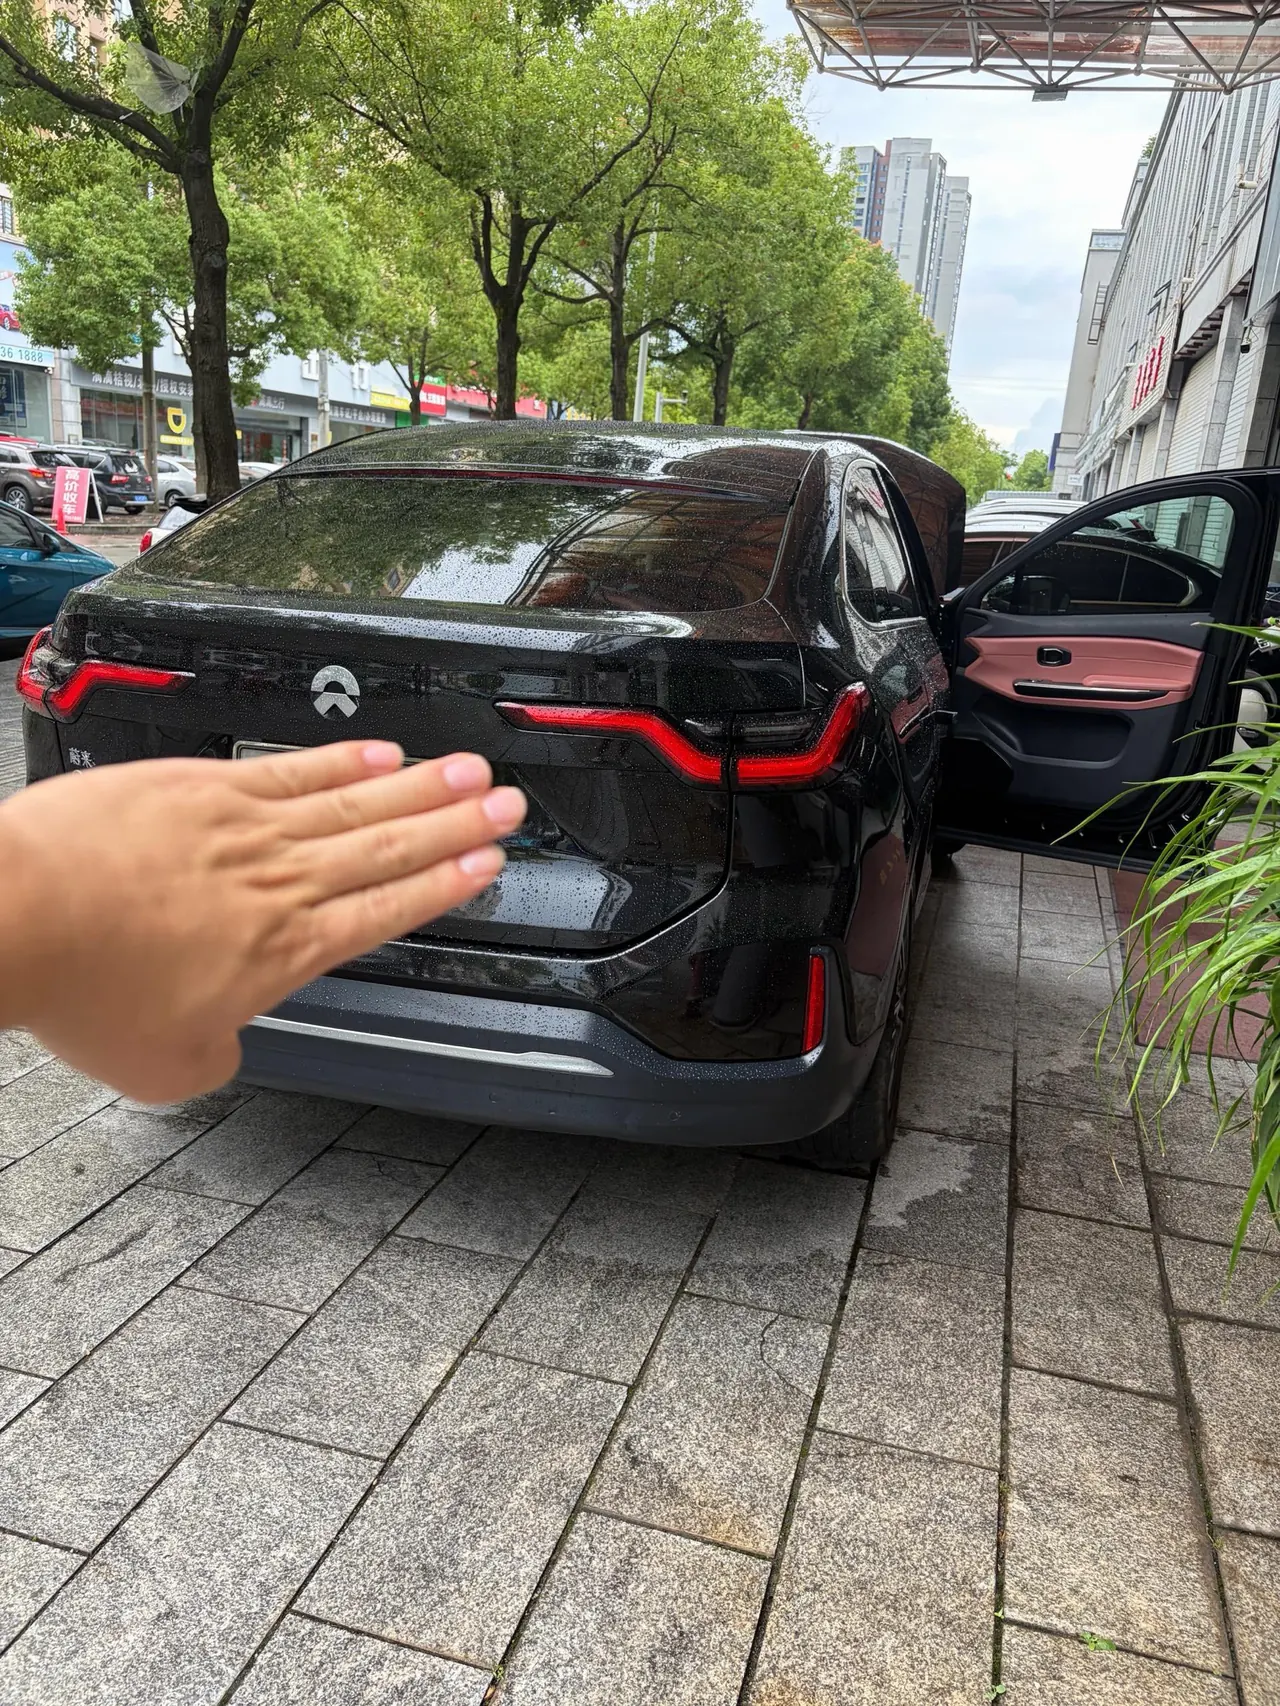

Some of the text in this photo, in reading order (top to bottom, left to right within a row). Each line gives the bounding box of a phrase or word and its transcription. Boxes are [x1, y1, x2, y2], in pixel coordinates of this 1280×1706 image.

[18, 349, 44, 363] 1888
[62, 469, 81, 515] 高价收车
[69, 747, 94, 768] 蔚来
